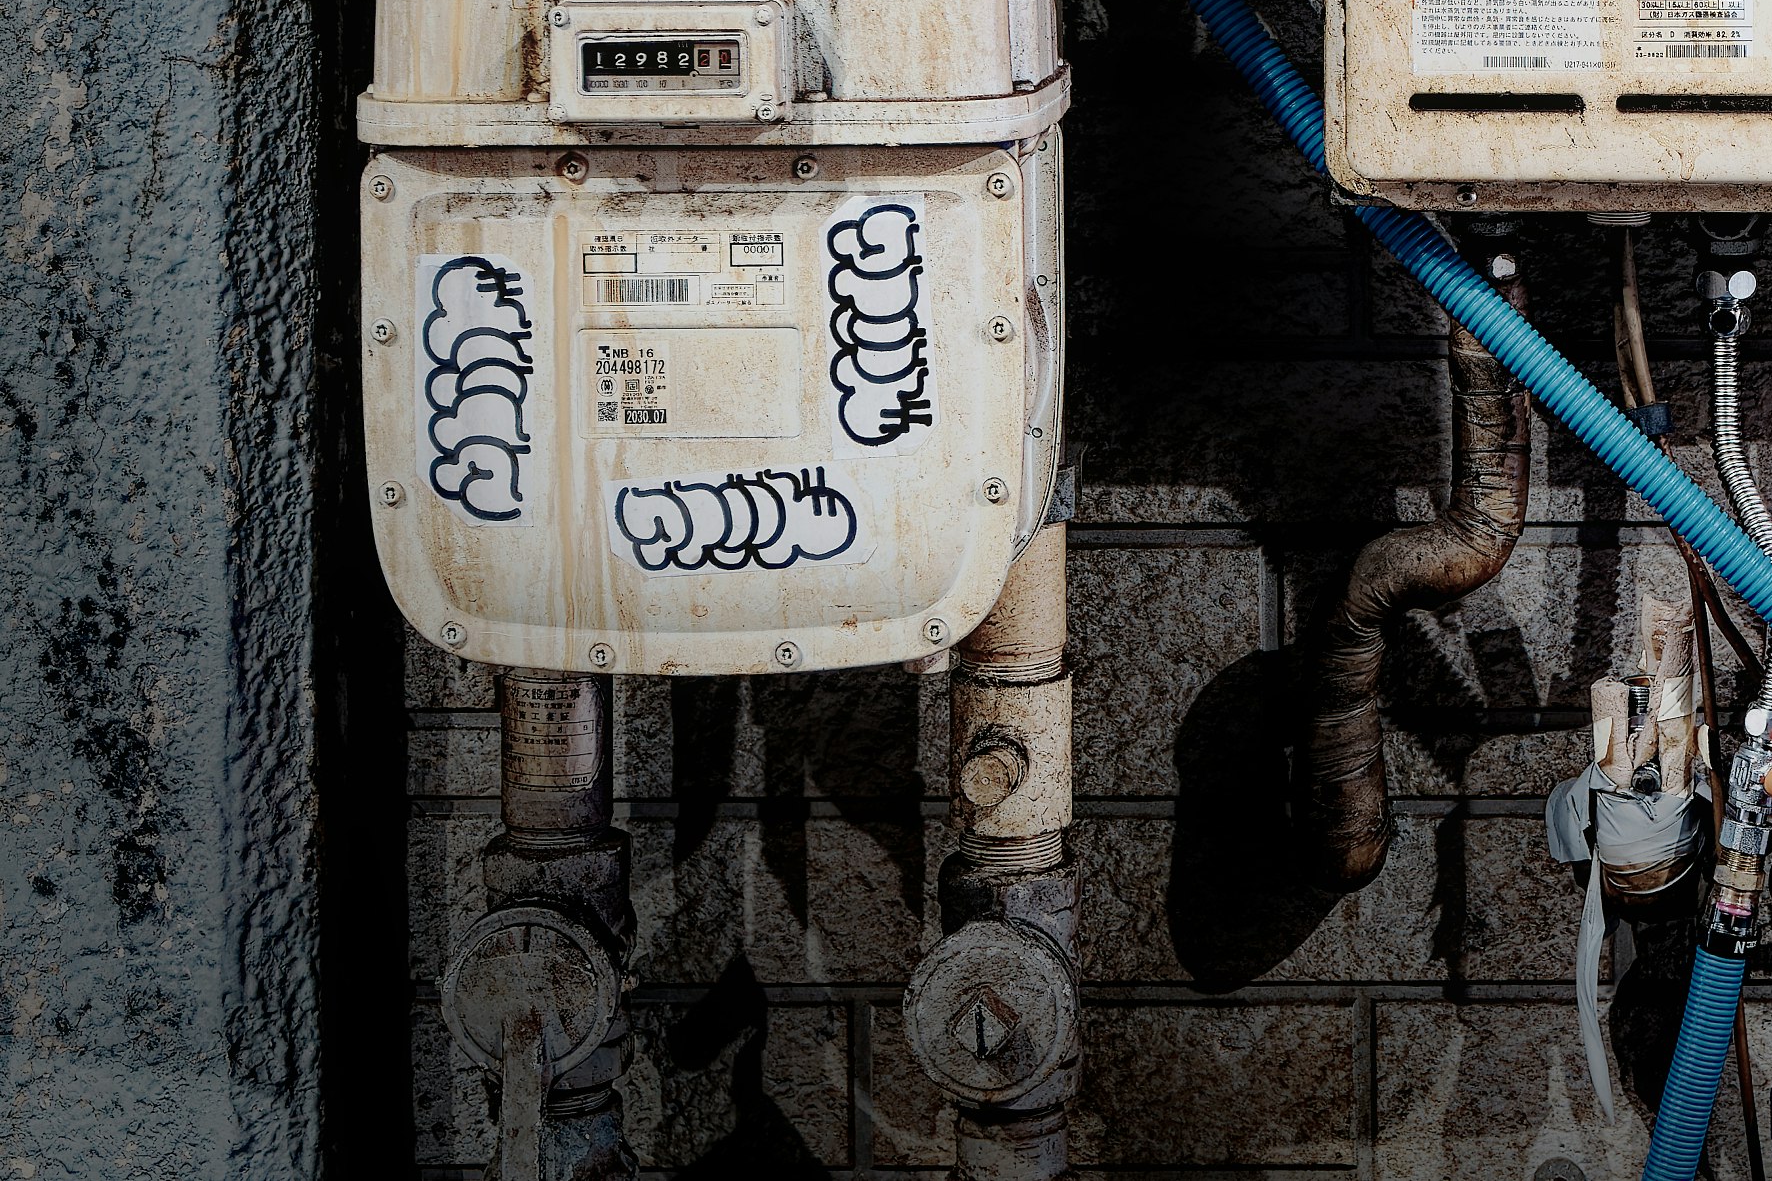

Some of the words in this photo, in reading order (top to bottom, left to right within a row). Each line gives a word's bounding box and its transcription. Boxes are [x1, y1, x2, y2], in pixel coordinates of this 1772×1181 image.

[612, 348, 629, 358] NB
[638, 348, 654, 358] 16
[596, 359, 665, 375] 204498172
[626, 409, 665, 424] 2030.07
